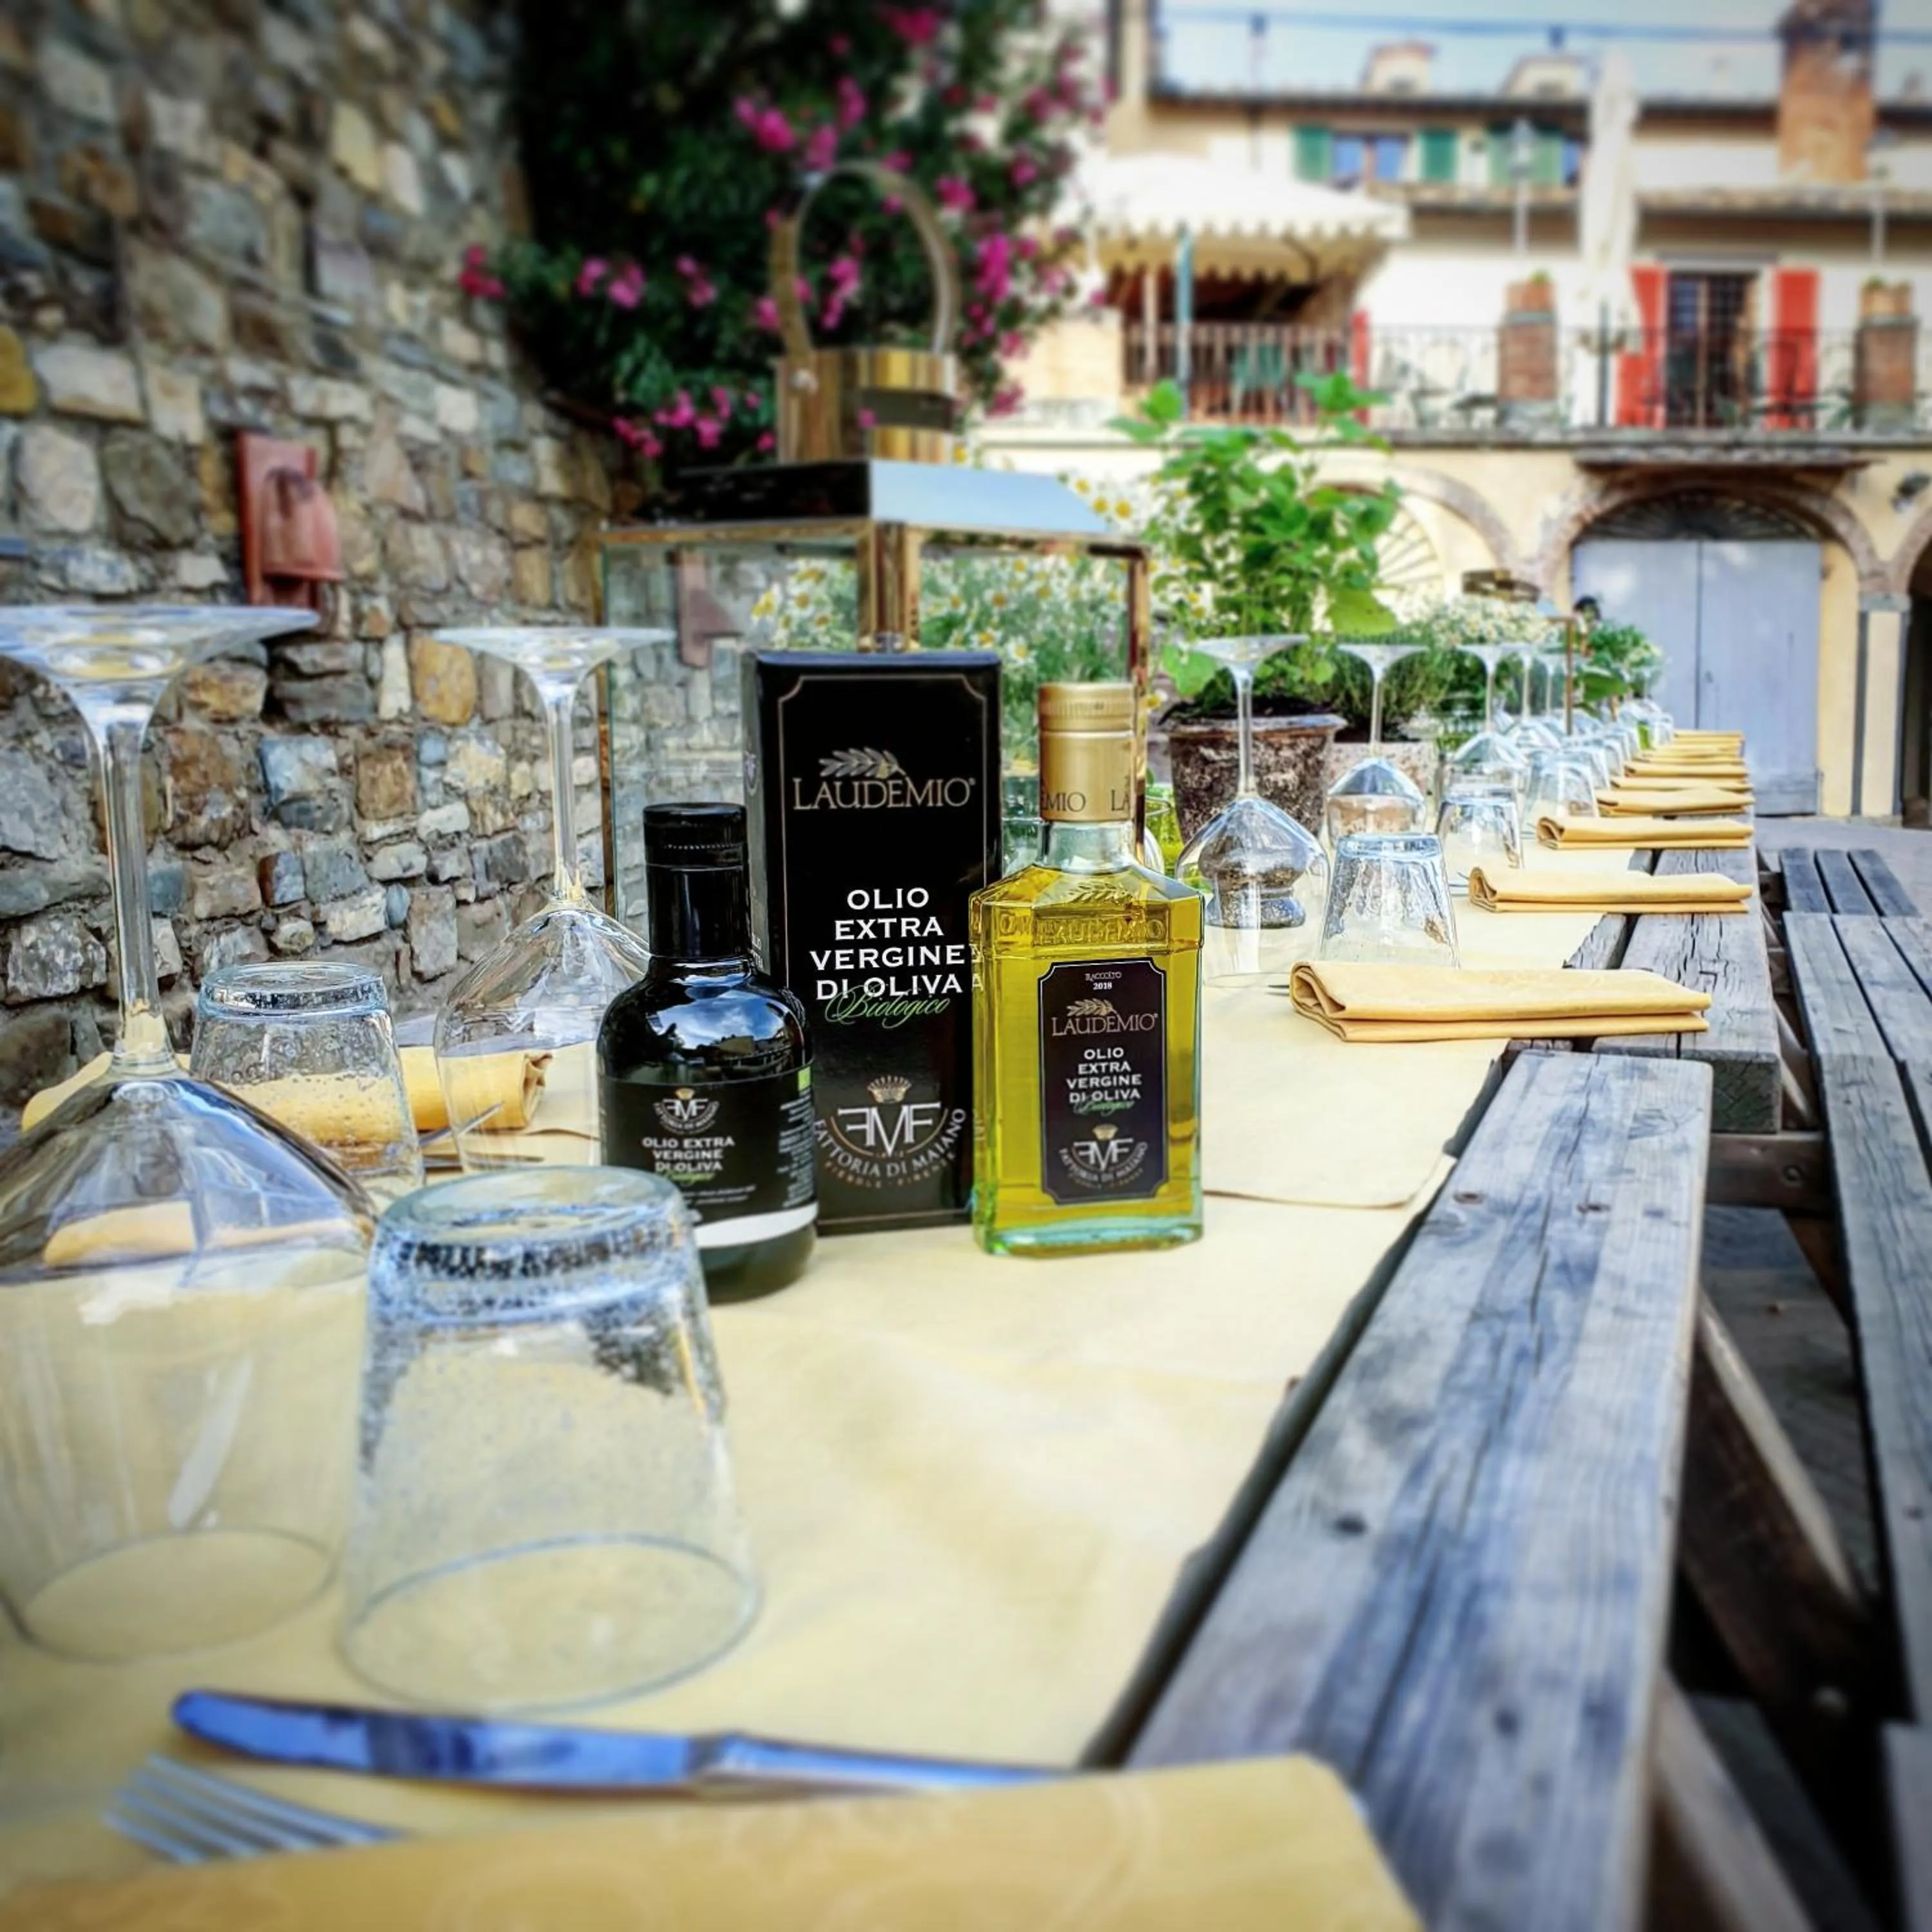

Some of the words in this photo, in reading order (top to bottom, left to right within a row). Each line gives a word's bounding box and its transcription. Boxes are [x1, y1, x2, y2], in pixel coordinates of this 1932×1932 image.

[793, 777, 976, 810] LAUDEMIO
[847, 887, 929, 911] OLIO
[835, 916, 943, 940] EXTRA
[810, 944, 965, 971] VERGINE
[816, 979, 849, 1000] DI
[864, 973, 963, 998] OLIVA
[825, 984, 951, 1028] Biologico
[1051, 1013, 1158, 1036] LAUDEMIO
[1083, 1047, 1124, 1060] OLIO
[1078, 1061, 1132, 1074] EXTRA
[1066, 1074, 1142, 1089] VERGINE
[1069, 1092, 1086, 1103] DI
[1092, 1088, 1141, 1101] OLIVA
[642, 1137, 679, 1148] OLIO
[683, 1137, 735, 1147] EXTRA
[813, 1119, 880, 1177] FATTORIA
[887, 1162, 907, 1177] DI
[912, 1108, 966, 1172] MAIANO
[652, 1150, 723, 1160] VERGINE
[655, 1162, 671, 1172] DI
[675, 1161, 723, 1172] OLIVA
